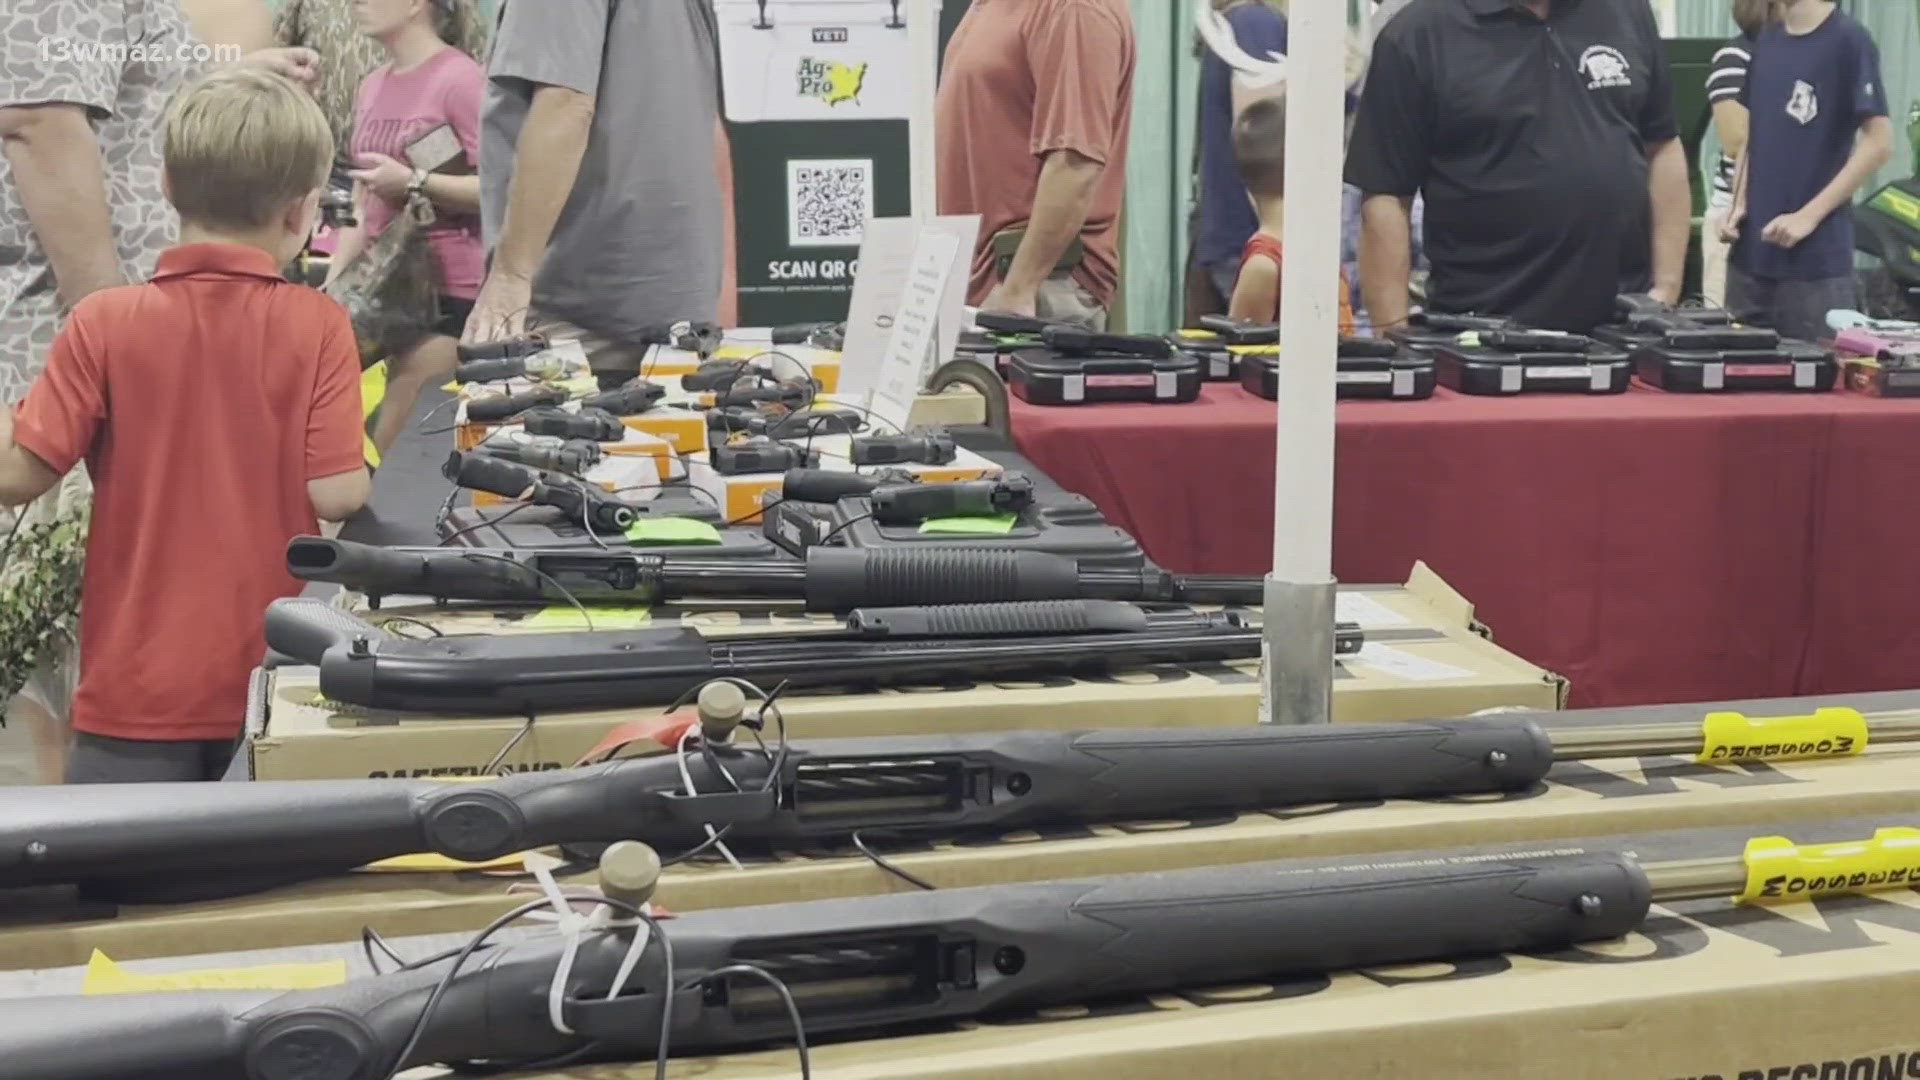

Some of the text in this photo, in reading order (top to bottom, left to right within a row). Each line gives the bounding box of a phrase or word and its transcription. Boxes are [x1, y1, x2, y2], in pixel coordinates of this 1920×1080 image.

[813, 29, 847, 41] YETI
[798, 77, 833, 94] Pro
[767, 260, 817, 280] SCAN
[819, 260, 846, 280] QR
[1711, 735, 1855, 759] MOSSBERG
[1758, 867, 1920, 897] MOSSBERG
